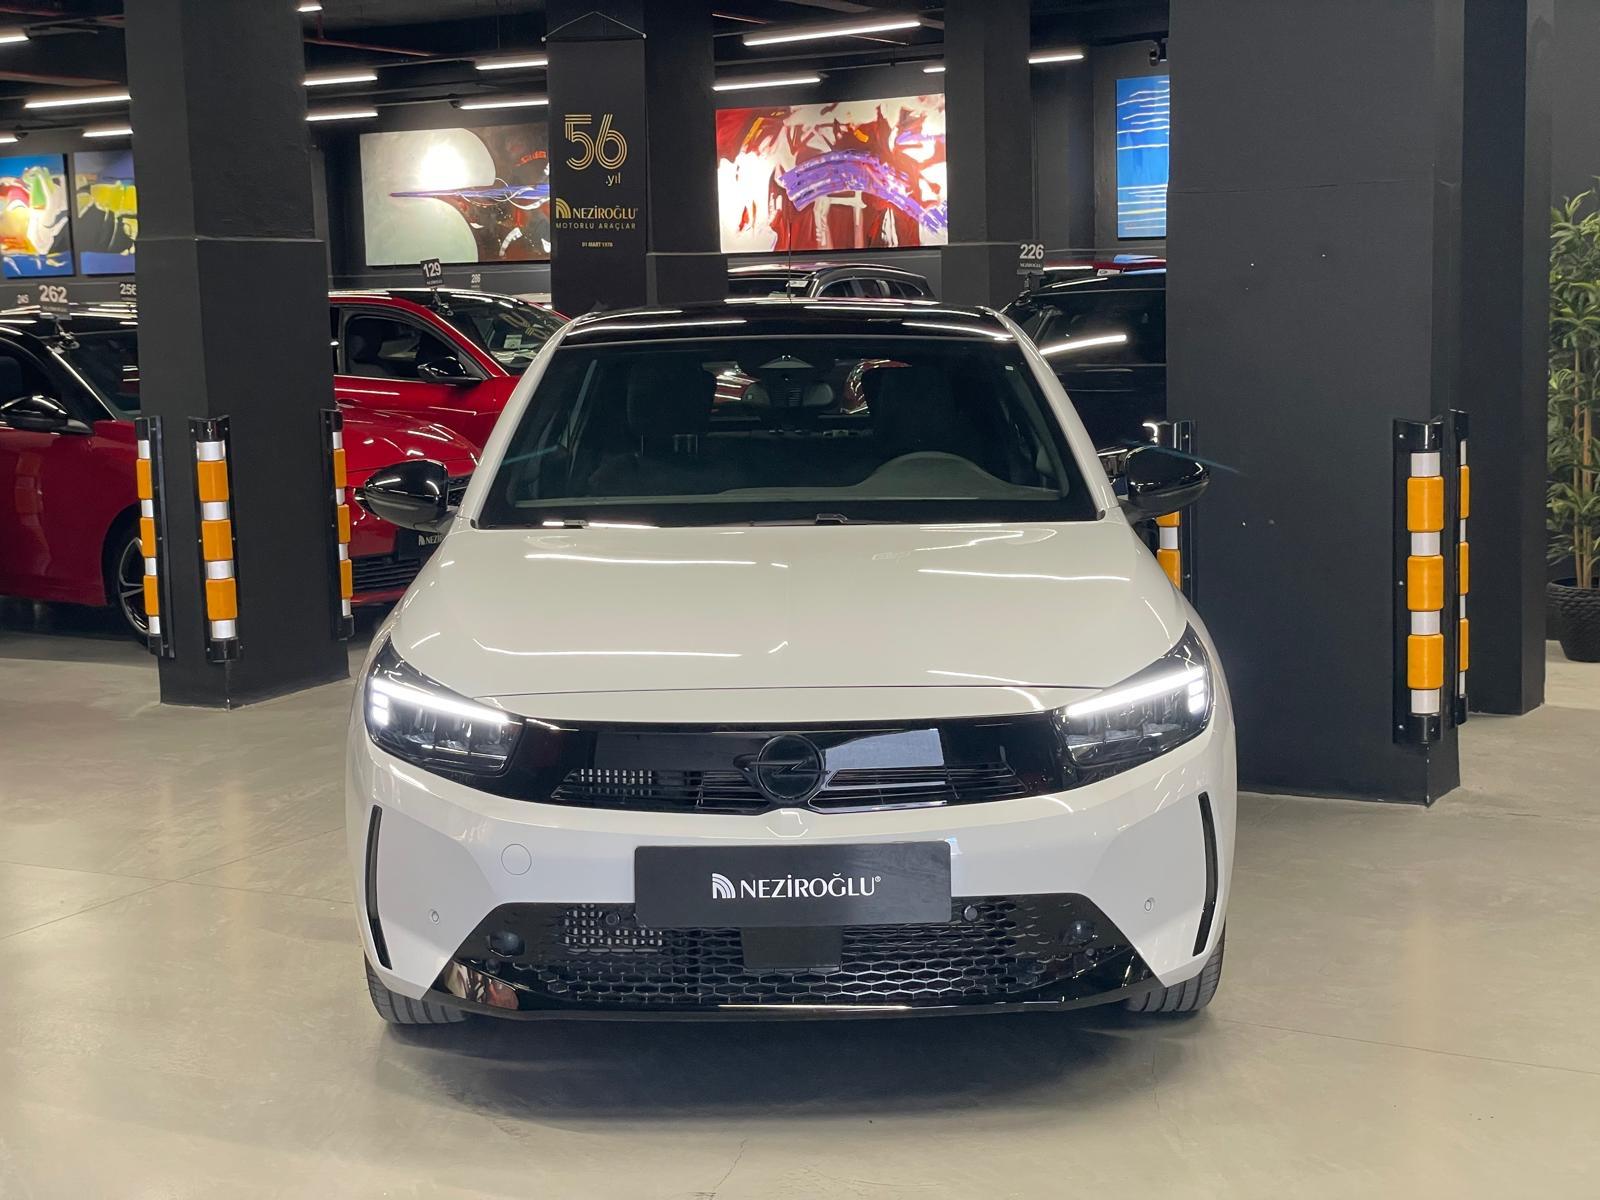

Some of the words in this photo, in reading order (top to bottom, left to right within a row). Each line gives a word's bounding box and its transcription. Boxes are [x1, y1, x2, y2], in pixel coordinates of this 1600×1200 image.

[564, 113, 628, 170] 56
[555, 222, 595, 230] MOTORLU
[598, 222, 636, 232] ARAÇLAR
[1019, 243, 1045, 260] 226
[423, 261, 442, 278] 129
[39, 284, 68, 304] 262
